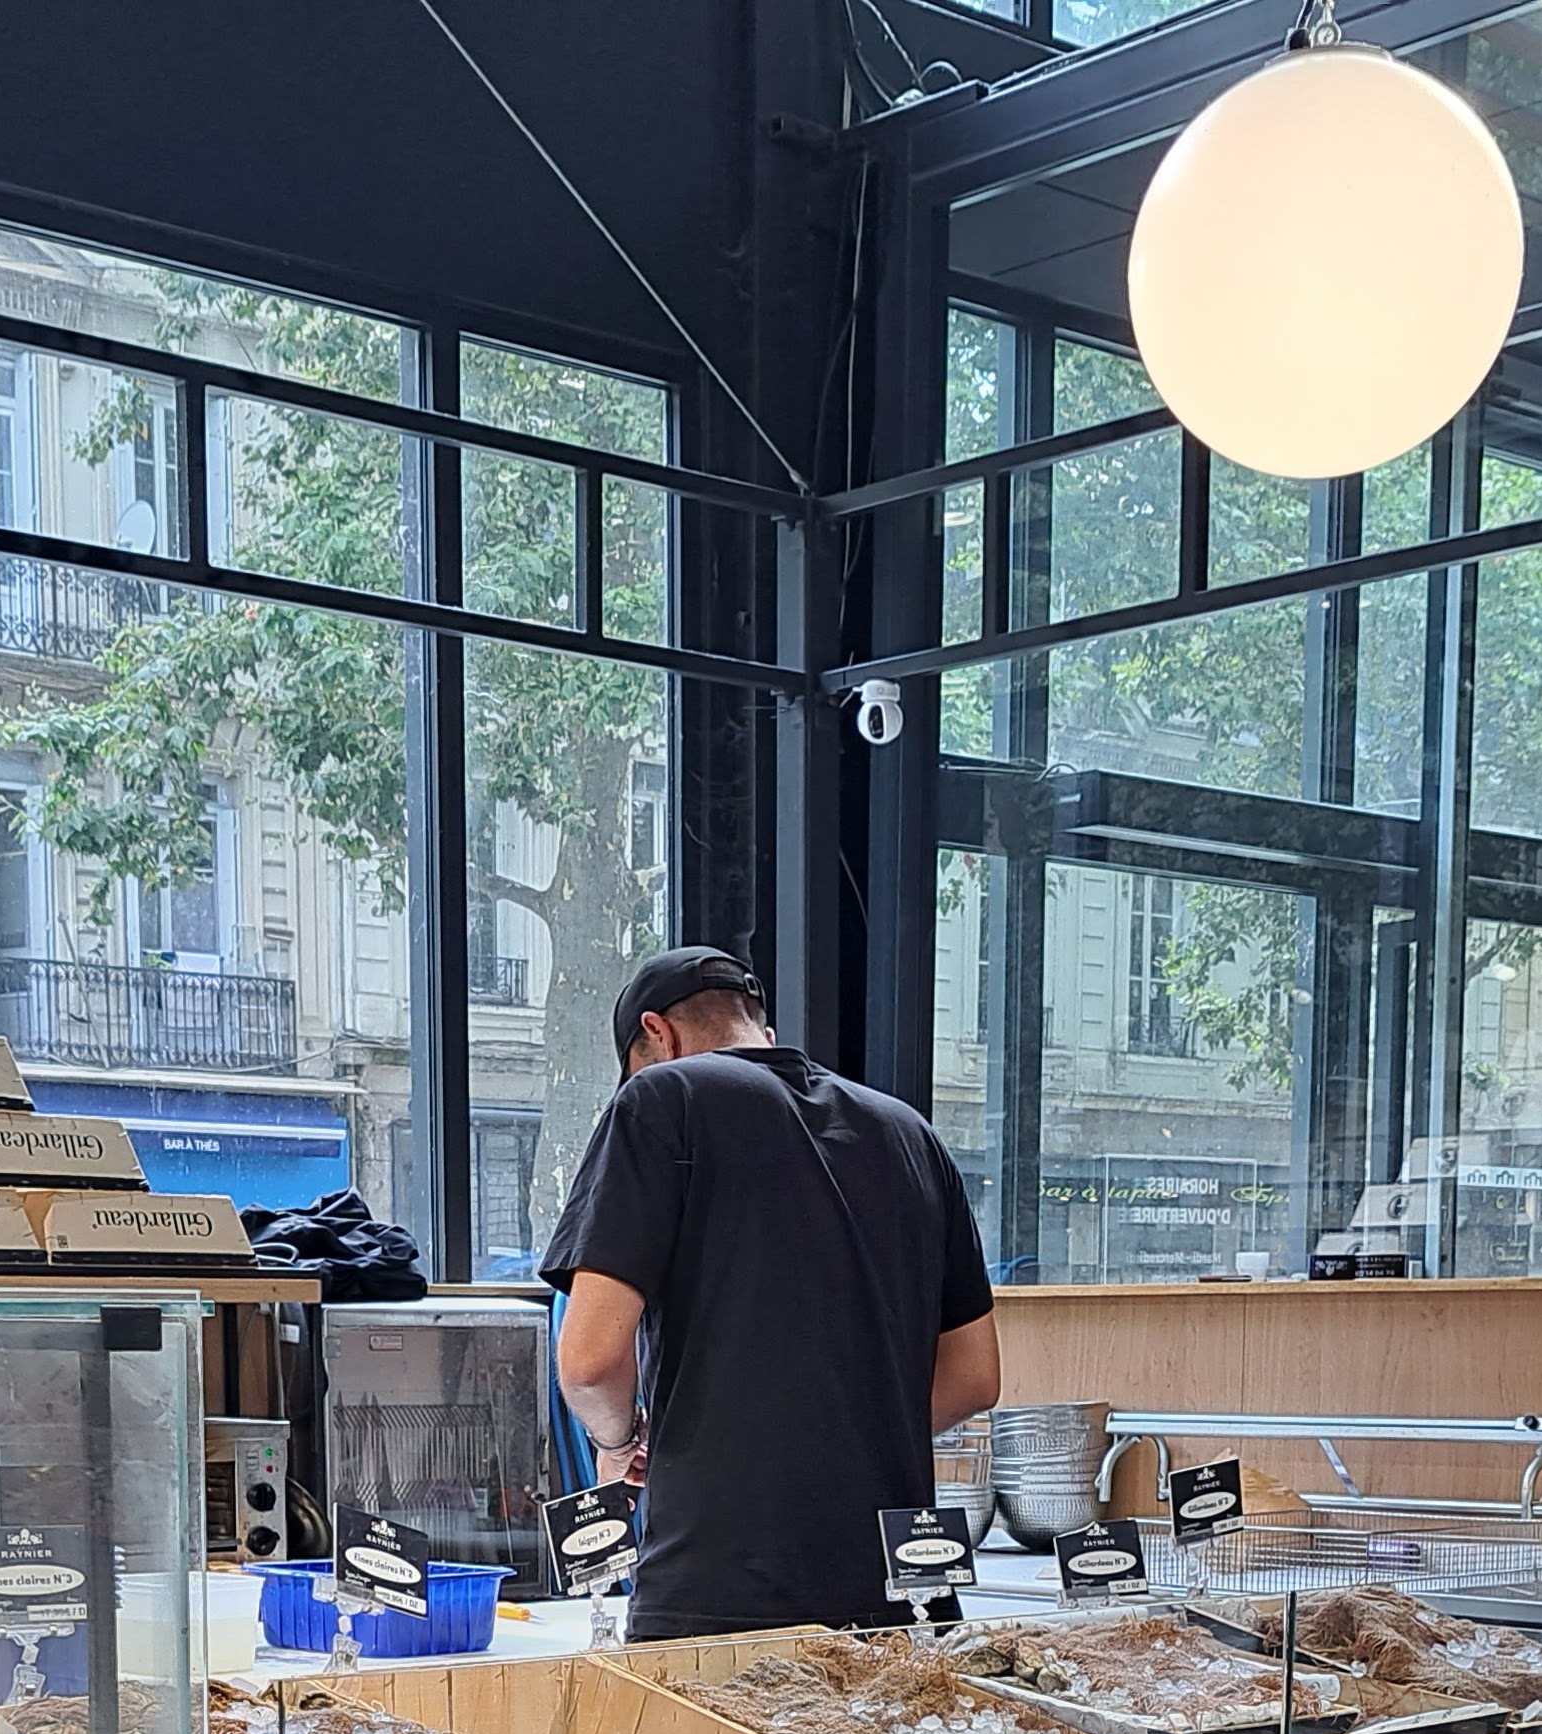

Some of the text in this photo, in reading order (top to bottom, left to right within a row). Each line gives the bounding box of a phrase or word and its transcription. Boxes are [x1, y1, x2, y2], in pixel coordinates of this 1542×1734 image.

[92, 1209, 214, 1238] Gillardeau
[0, 1549, 53, 1560] RAYNIER
[16, 1574, 52, 1586] claires
